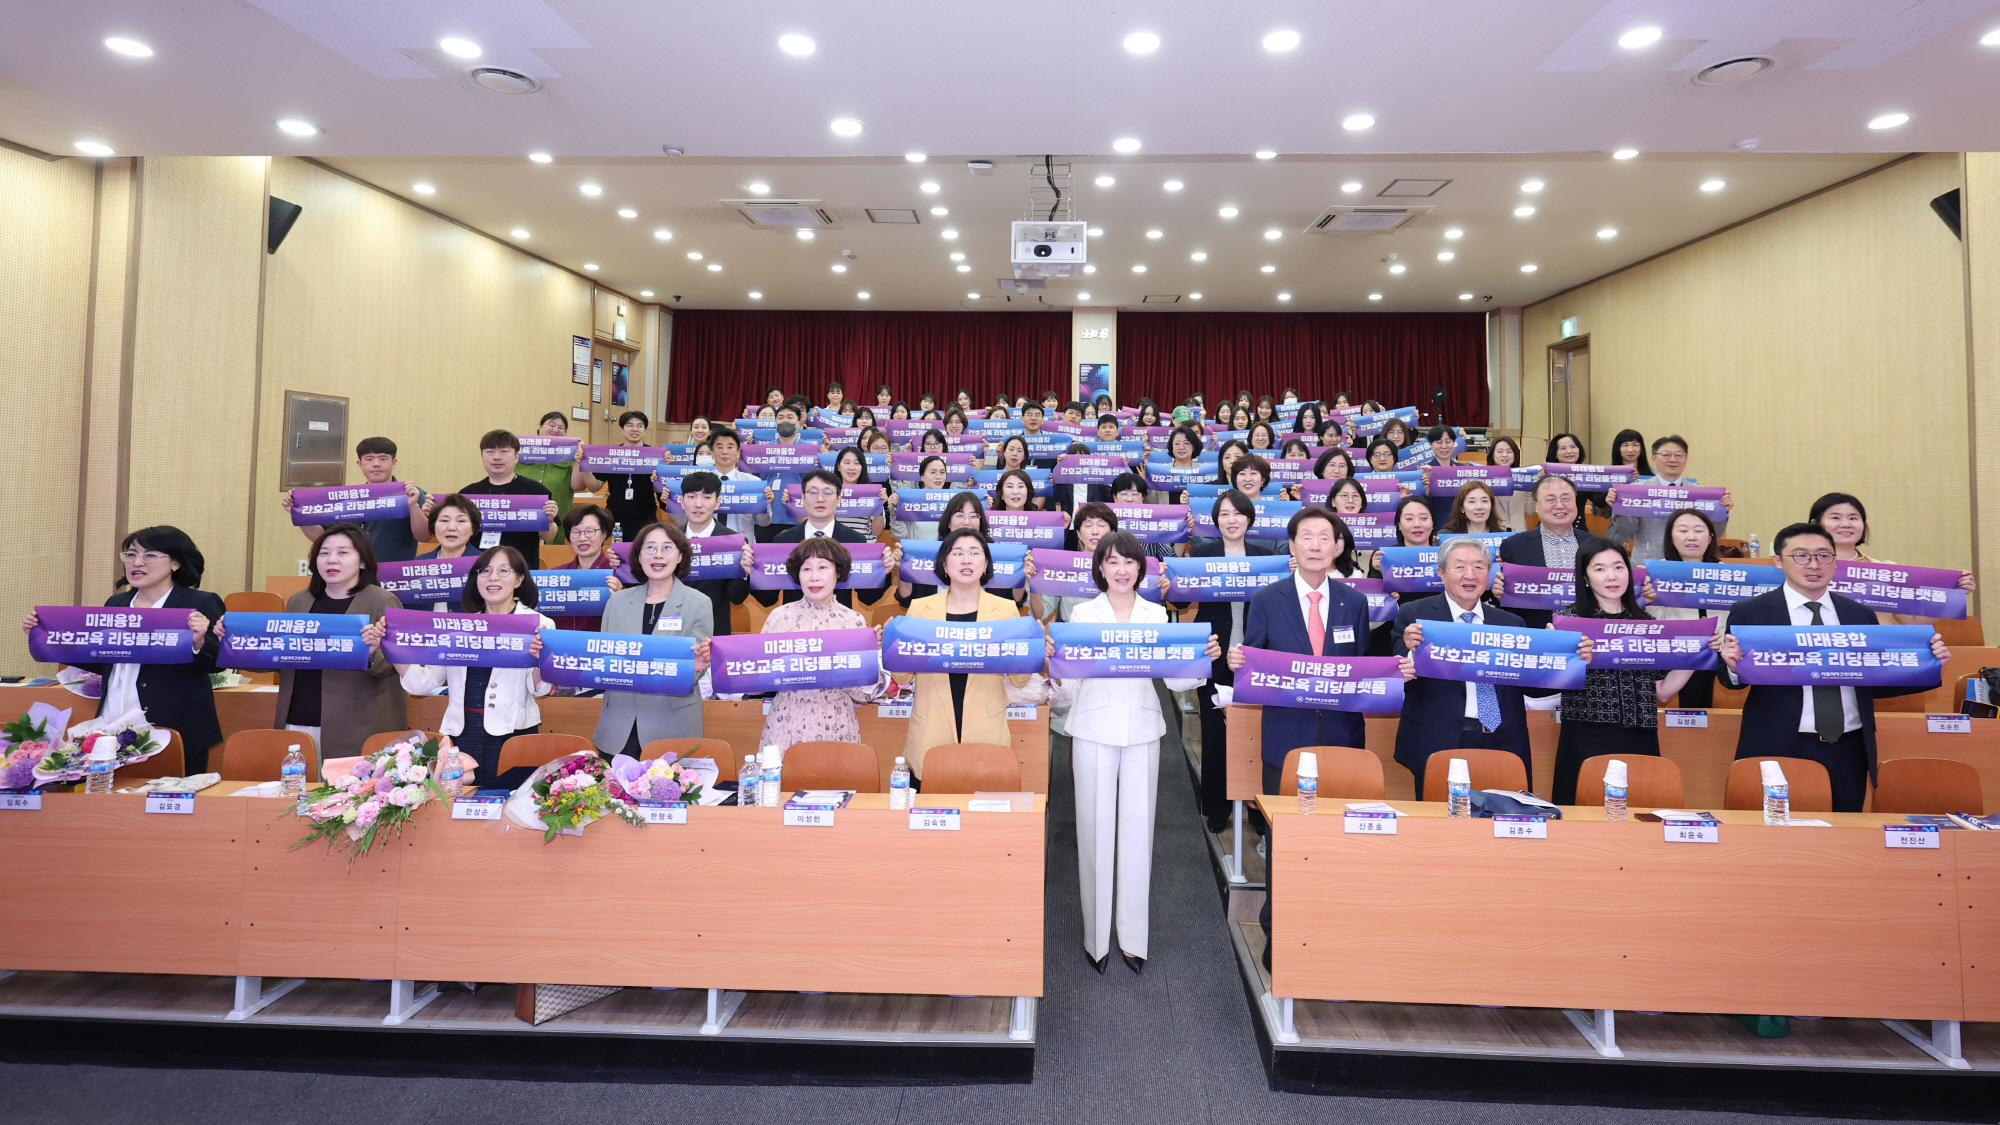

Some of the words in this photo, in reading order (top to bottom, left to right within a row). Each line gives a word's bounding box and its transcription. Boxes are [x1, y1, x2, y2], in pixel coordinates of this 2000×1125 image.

[532, 447, 571, 455] 리딩플랫폼
[766, 447, 796, 455] 미래융합
[621, 458, 659, 466] 리딩플랫폼
[746, 456, 776, 464] 간호교육
[778, 456, 814, 465] 리딩플랫폼
[1079, 458, 1108, 466] 미래융합
[1457, 469, 1488, 477] 미래융합
[1585, 474, 1627, 483] 리딩플랫폼
[328, 489, 370, 500] 미래융합
[1310, 494, 1327, 503] 간호
[1648, 488, 1689, 498] 미래융합
[302, 502, 344, 514] 간호교육
[347, 498, 396, 511] 리딩플랫폼
[904, 503, 937, 511] 간호교육
[1622, 498, 1662, 509] 간호교육
[488, 511, 537, 520] 리딩플랫폼
[989, 515, 1029, 525] 미래융합
[1130, 520, 1178, 532] 리딩플랫폼
[1005, 528, 1053, 539] 리딩플랫폼
[1419, 552, 1438, 563] 미래
[402, 563, 453, 577] 미래융합
[912, 559, 935, 570] 간호
[1205, 562, 1250, 573] 미래융합
[1044, 569, 1089, 583] 간호교육
[1392, 566, 1434, 578] 간호교육
[1548, 572, 1575, 582] 미래
[1693, 568, 1747, 582] 미래융합
[1847, 567, 1909, 583] 미래융합
[426, 576, 468, 589] 리딩플
[1177, 577, 1222, 588] 간호교육
[1514, 583, 1564, 595] 간호교육
[1656, 580, 1710, 595] 간호교육
[545, 589, 600, 602] 리딩플랫폼
[1871, 584, 1947, 603] 리딩플랫폼
[86, 614, 142, 628] 미래융합
[266, 619, 320, 634] 미래융합
[432, 618, 488, 632] 미래융합
[936, 627, 993, 640] 미래융합
[1604, 623, 1665, 635] 미래융합
[46, 631, 104, 645] 간호교육
[108, 632, 179, 647] 리딩플랫폼
[395, 632, 451, 648] 간호교육
[456, 635, 524, 650] 리딩플랫폼
[1101, 630, 1159, 643] 미래융합
[1471, 632, 1532, 649] 미래융합
[1795, 632, 1867, 647] 미래융합
[231, 637, 285, 650] 간호교육
[289, 638, 354, 652] 리딩플랫폼
[587, 639, 643, 656] 미래융합
[764, 638, 823, 654] 미래융합
[898, 642, 955, 657] 간호교육
[959, 642, 1029, 657] 리딩플랫폼
[1593, 639, 1624, 653] 교육
[1629, 639, 1701, 653] 리딩플랫폼
[1064, 647, 1121, 660] 간호교육
[1125, 647, 1195, 660] 리딩플랫폼
[1430, 646, 1490, 666] 간호교육
[1495, 652, 1566, 670] 리딩플랫폼
[1753, 651, 1822, 667] 간호교육
[1828, 651, 1919, 667] 리딩플랫폼
[552, 655, 605, 672] 간호교육
[610, 659, 679, 676] 리딩플랫폼
[726, 660, 786, 676] 간호교육
[790, 654, 862, 672] 리딩플랫폼
[1291, 660, 1352, 677] 미래융합
[1250, 672, 1310, 692] 간호교육
[1315, 680, 1386, 695] 리딩플랫폼
